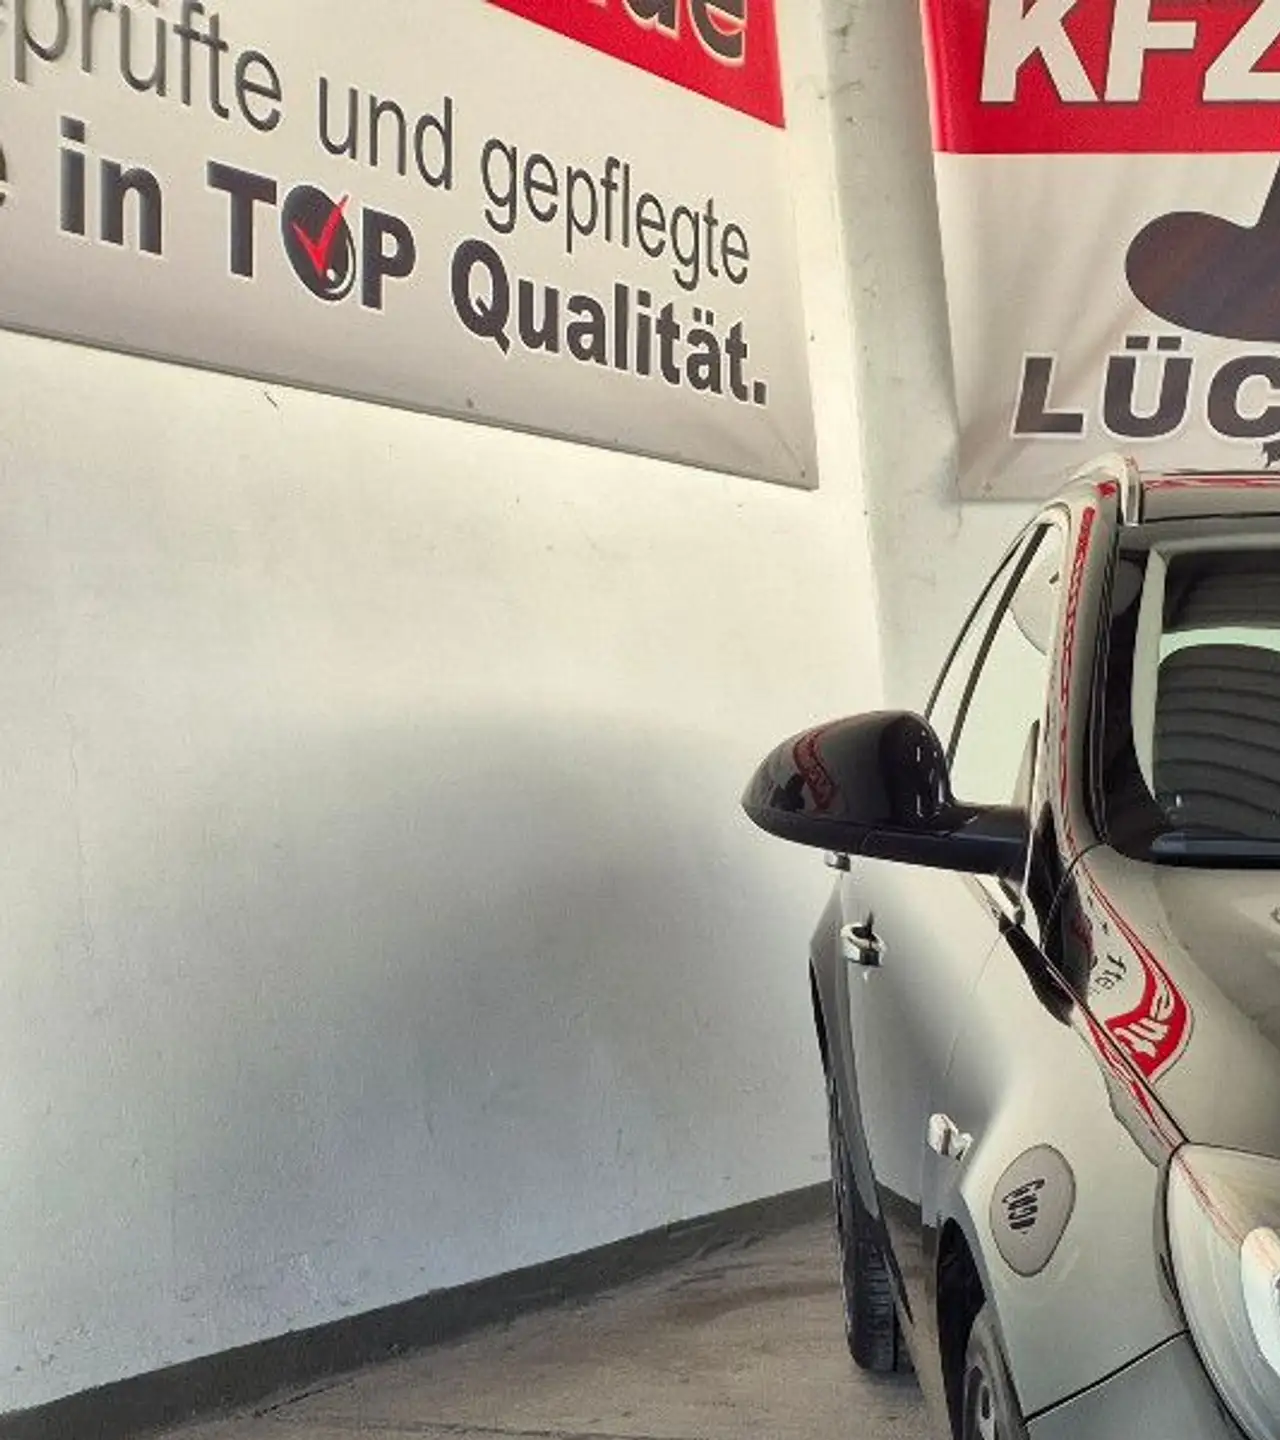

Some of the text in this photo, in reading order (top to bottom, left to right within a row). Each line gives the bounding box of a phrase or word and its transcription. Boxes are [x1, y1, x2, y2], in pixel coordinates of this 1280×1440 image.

[60, 115, 163, 255] in
[206, 160, 416, 310] TOP
[450, 239, 768, 405] Qualität.
[319, 75, 454, 191] und
[481, 138, 751, 292] gepflegte
